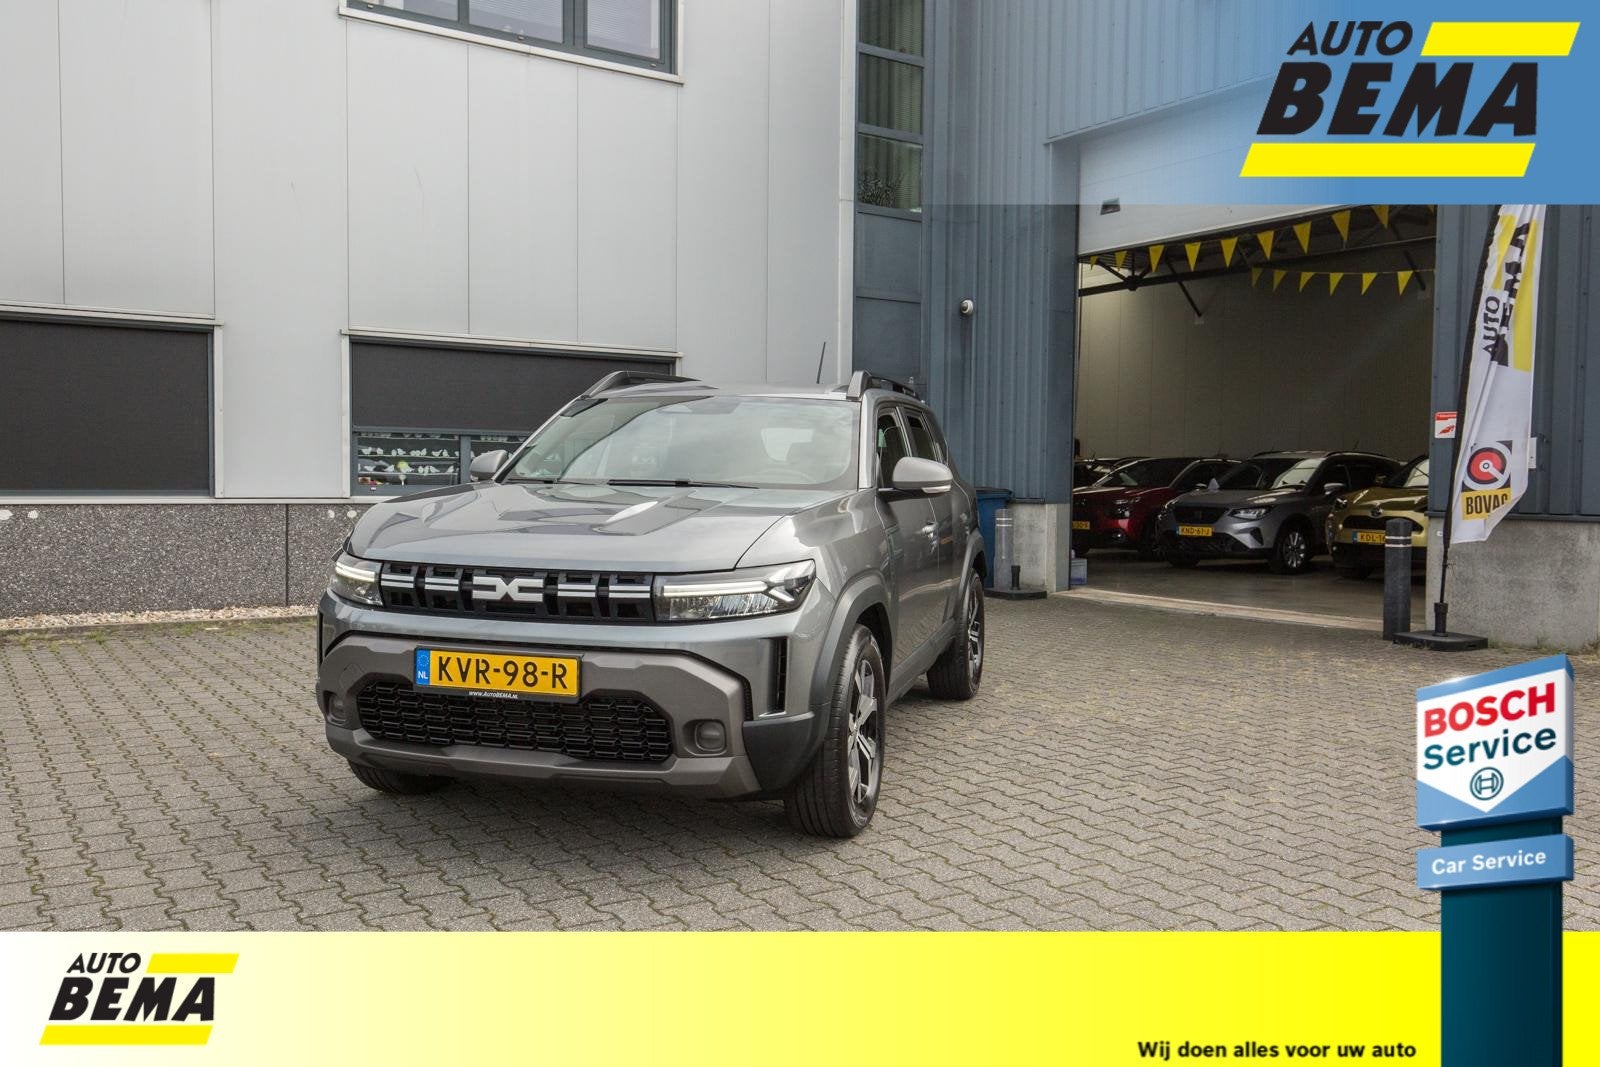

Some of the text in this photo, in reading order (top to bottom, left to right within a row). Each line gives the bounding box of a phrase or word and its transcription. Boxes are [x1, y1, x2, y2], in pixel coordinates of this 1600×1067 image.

[1483, 296, 1501, 358] AUTO
[417, 656, 568, 689] NL KVR-98-R
